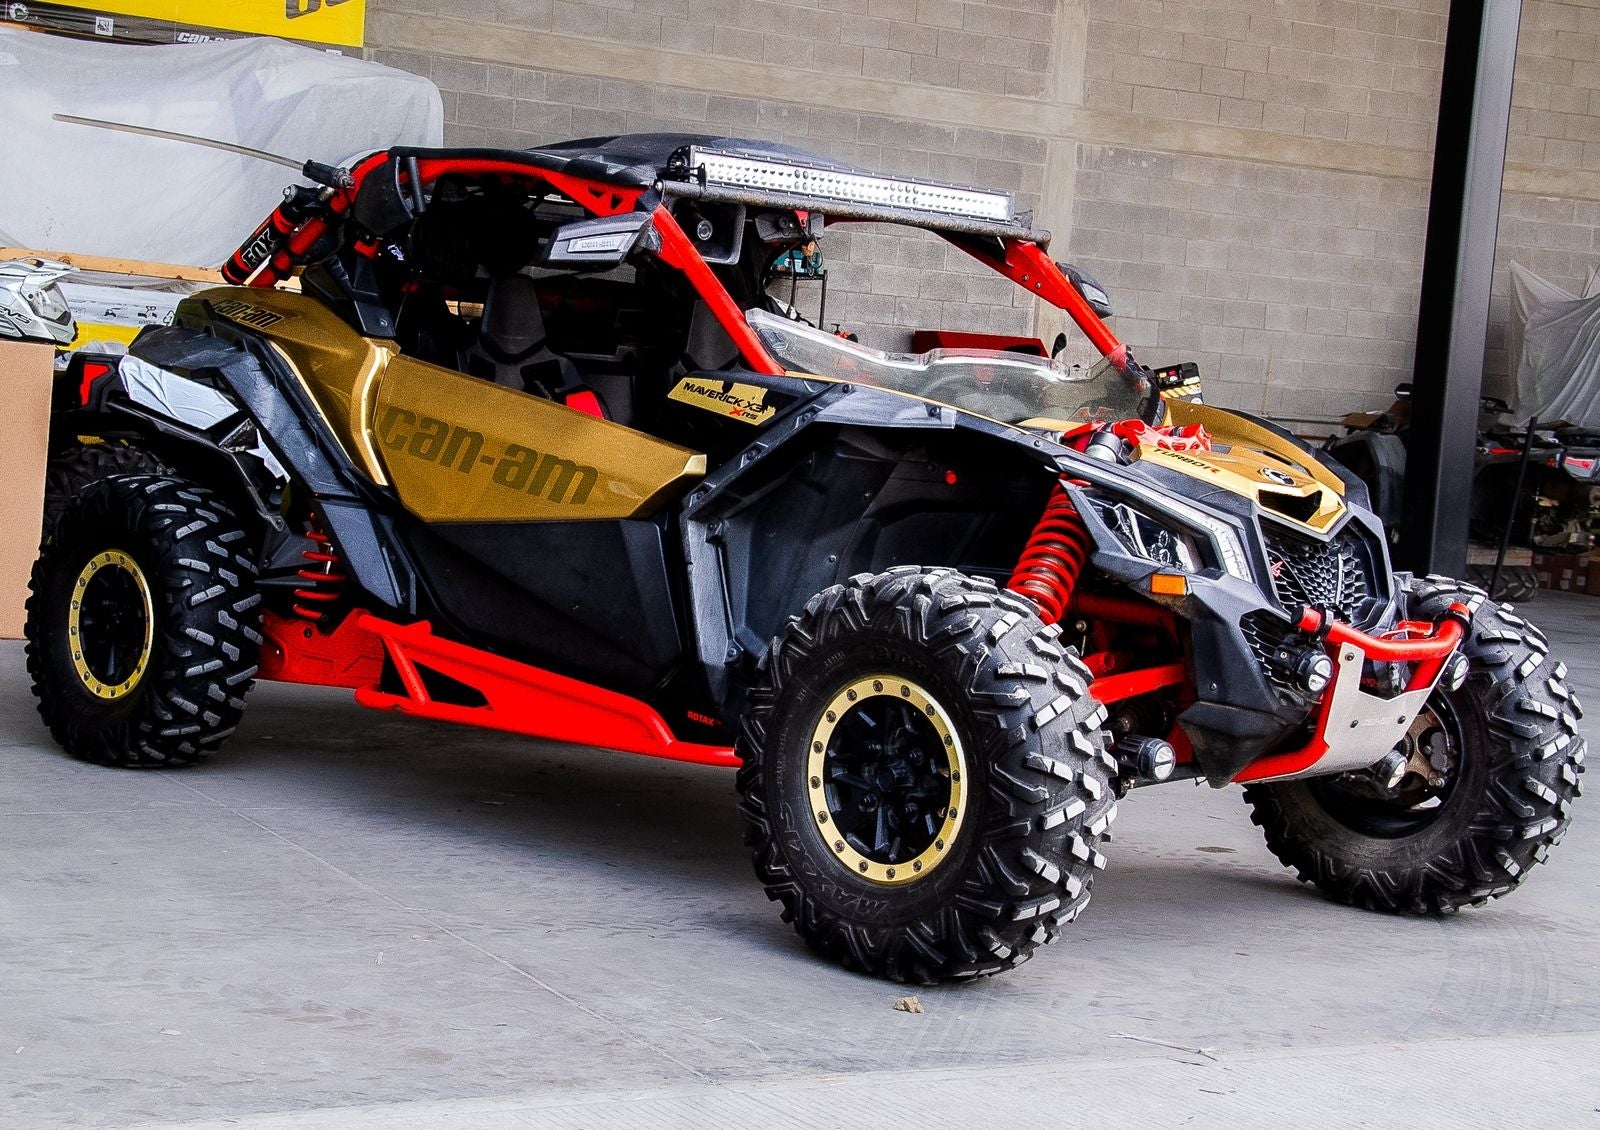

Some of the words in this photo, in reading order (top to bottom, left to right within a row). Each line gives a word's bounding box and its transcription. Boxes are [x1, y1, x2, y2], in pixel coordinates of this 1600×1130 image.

[242, 227, 276, 268] FOX
[212, 298, 284, 329] can-am
[683, 382, 744, 407] MAVERICK
[743, 401, 762, 413] X3
[378, 406, 598, 505] can-am
[687, 709, 715, 727] ROTAX
